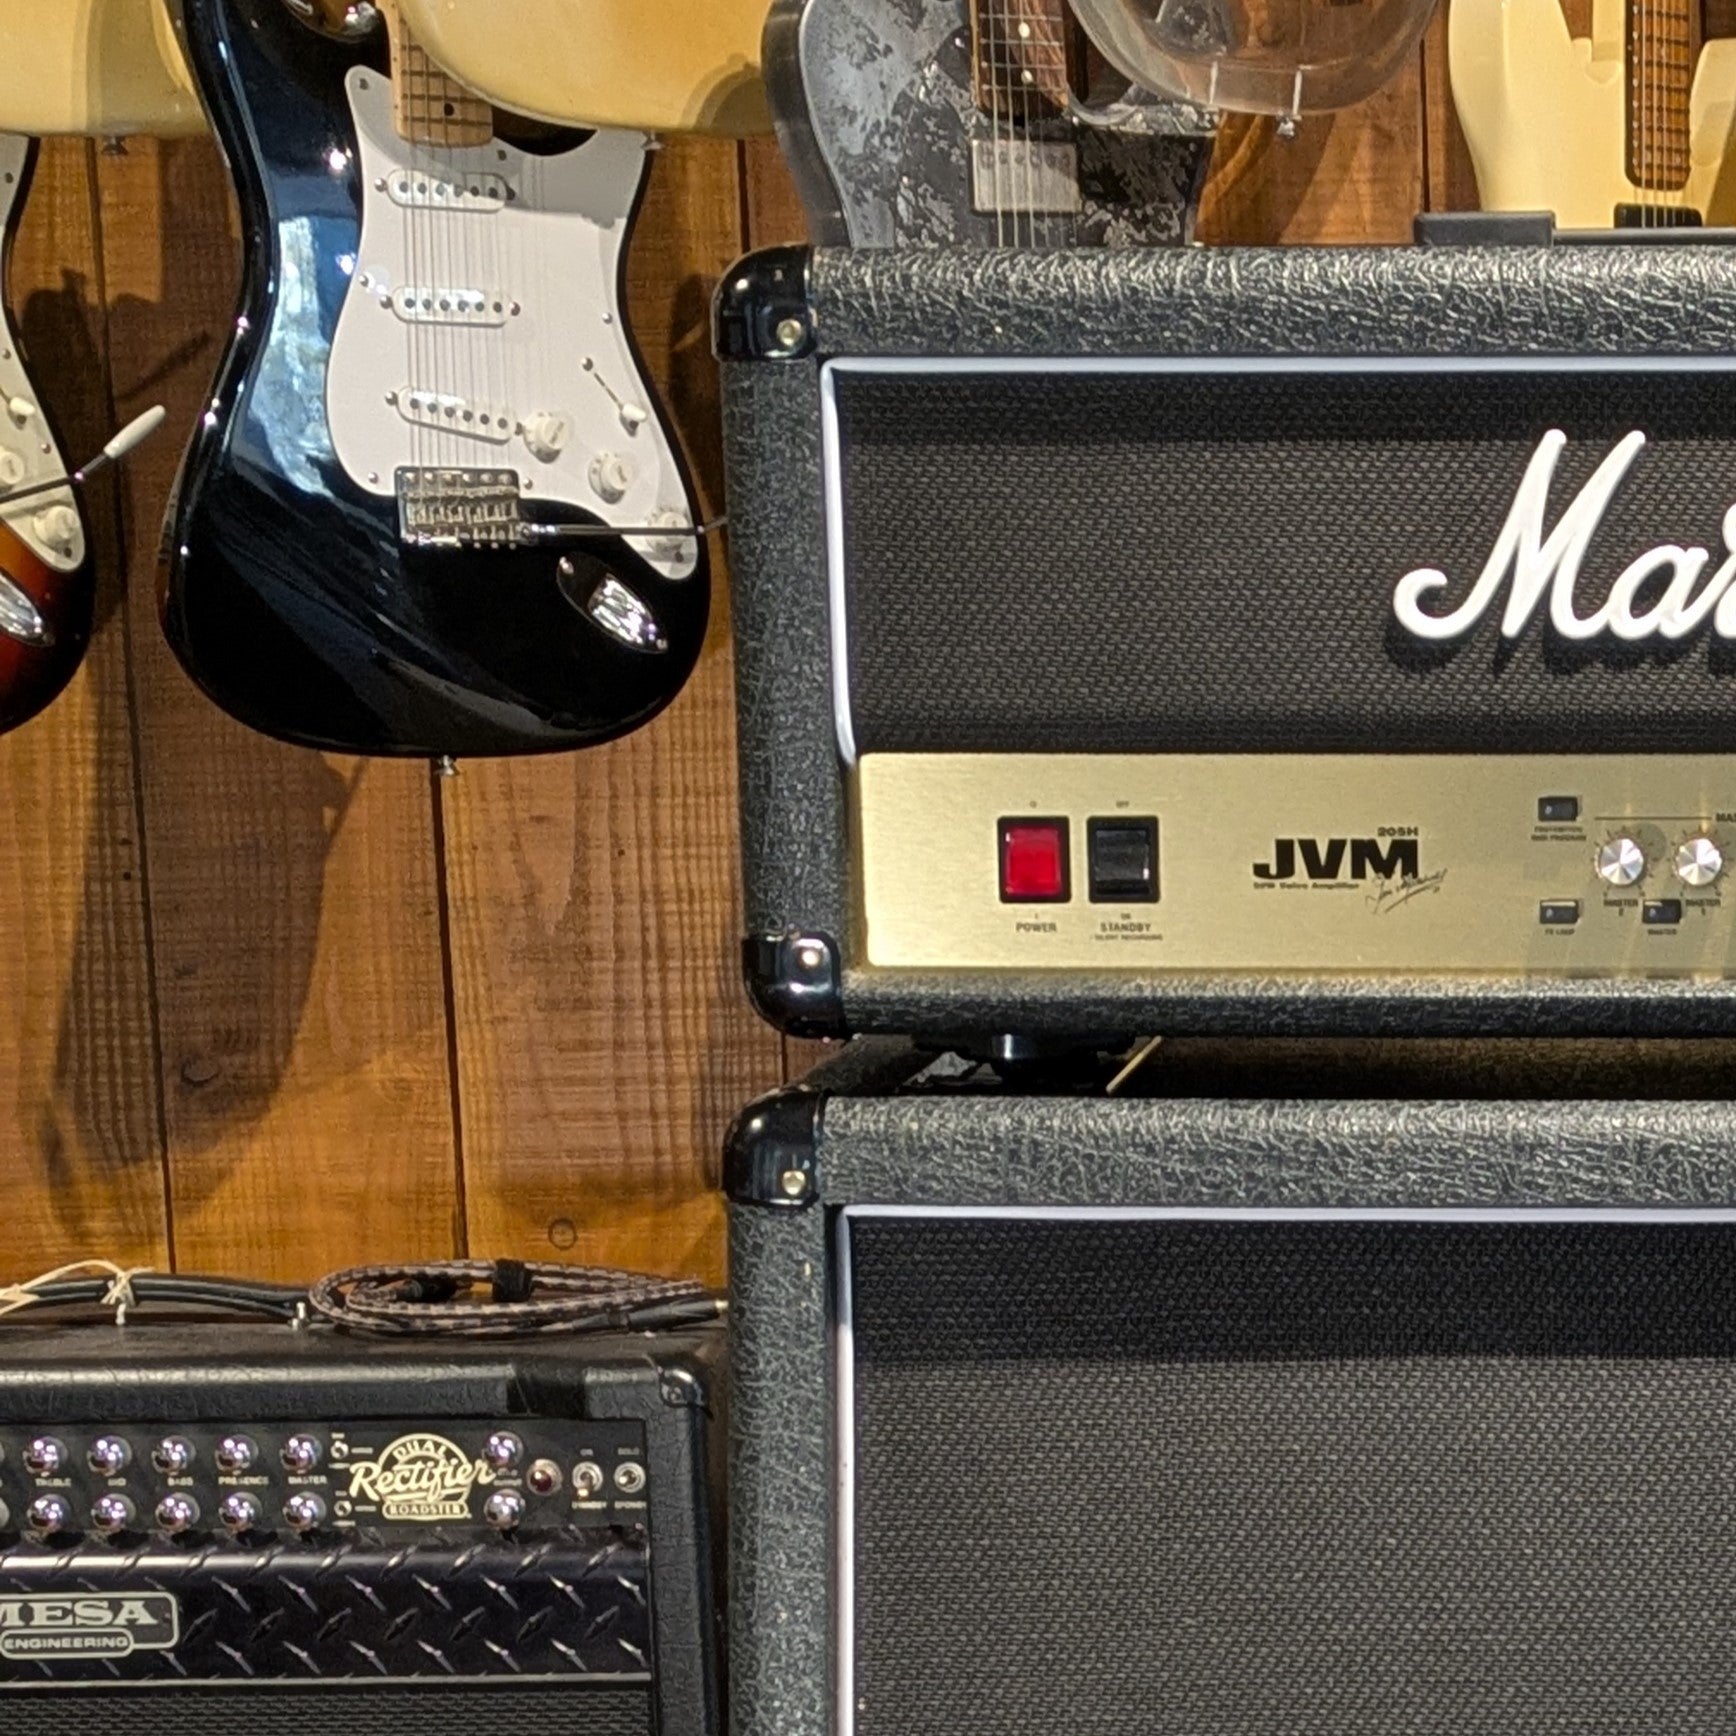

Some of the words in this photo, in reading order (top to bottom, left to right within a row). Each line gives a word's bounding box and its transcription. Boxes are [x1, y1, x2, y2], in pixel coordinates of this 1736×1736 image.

[1252, 838, 1419, 880] JVM
[1015, 922, 1057, 932] POWER
[1100, 922, 1152, 932] STANDBY
[392, 1440, 448, 1460] DUAL
[167, 1477, 194, 1487] BASS
[217, 1476, 269, 1486] PRESENCE
[287, 1475, 328, 1485] MASTER
[349, 1457, 497, 1503] Rectifier
[389, 1503, 461, 1515] ROADSTER
[4, 1636, 129, 1649] ENGINEERING
